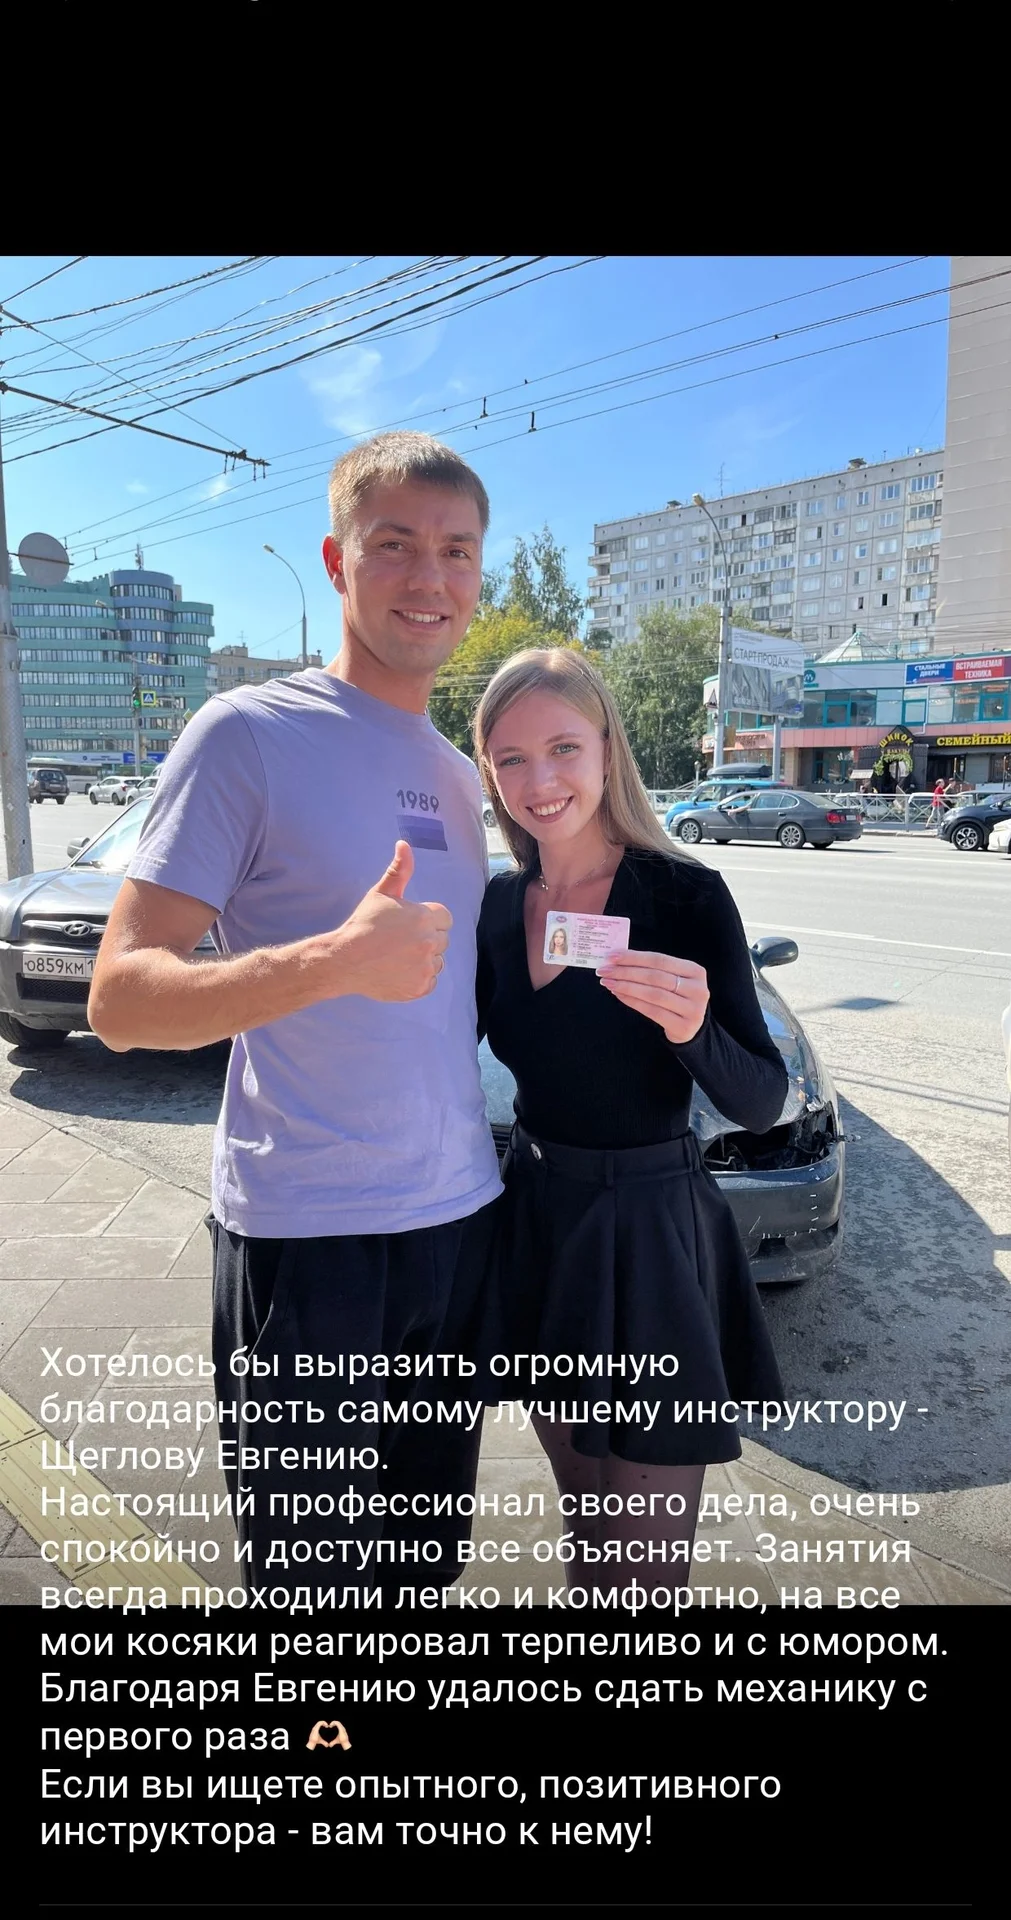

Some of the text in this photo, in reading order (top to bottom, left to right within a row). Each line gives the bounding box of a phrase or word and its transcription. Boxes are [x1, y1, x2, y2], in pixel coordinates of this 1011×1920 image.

[734, 647, 790, 669] СТАРТ ПРОДАЖ
[955, 658, 1003, 671] ВСТРАИВАЕМАЯ
[914, 663, 946, 671] СТАЛЬНЫЕ
[919, 670, 940, 678] ДВЕРИ
[965, 669, 992, 679] ТЕХНИКА
[879, 732, 914, 748] ШИНОК
[936, 732, 1011, 747] СЕМЕЙНЫЙ
[396, 789, 440, 814] 1989
